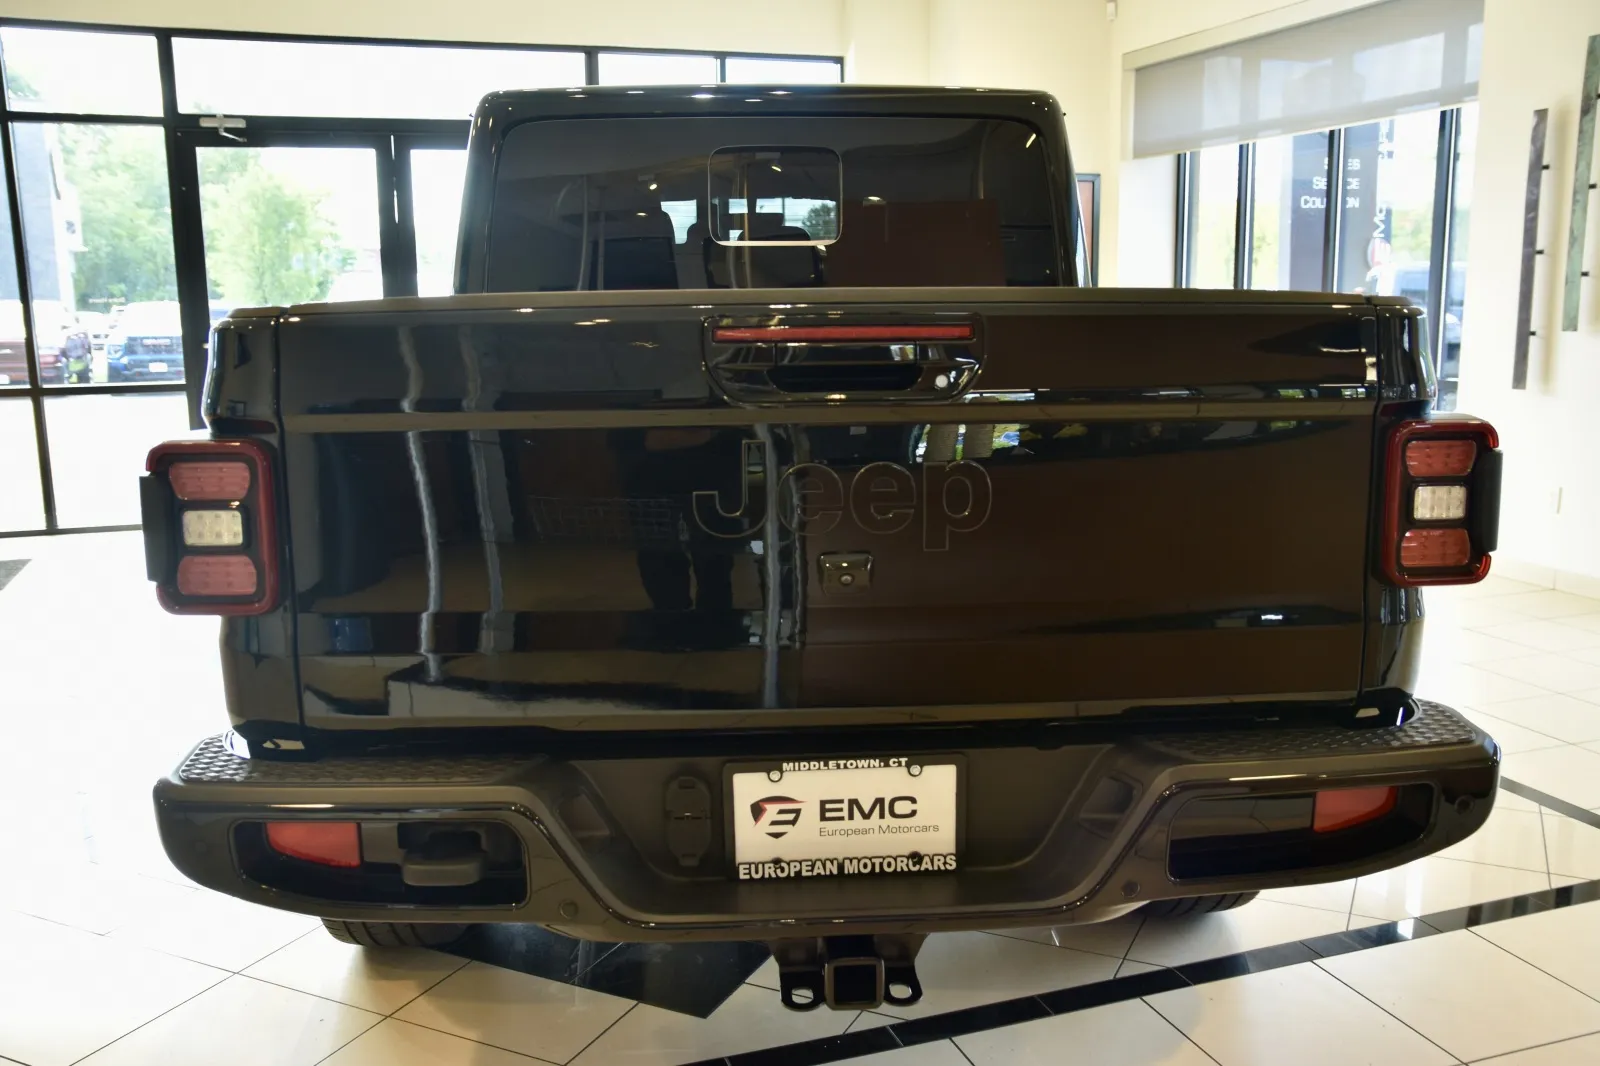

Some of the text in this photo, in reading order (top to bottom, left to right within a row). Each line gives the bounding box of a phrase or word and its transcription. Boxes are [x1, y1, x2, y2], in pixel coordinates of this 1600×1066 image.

[1312, 176, 1360, 190] SECE
[693, 439, 992, 551] Jeep
[889, 757, 909, 768] CT
[819, 795, 918, 822] EMC
[819, 824, 940, 838] European Motorcars
[738, 854, 957, 880] EUROPEAN MOTORCARS
